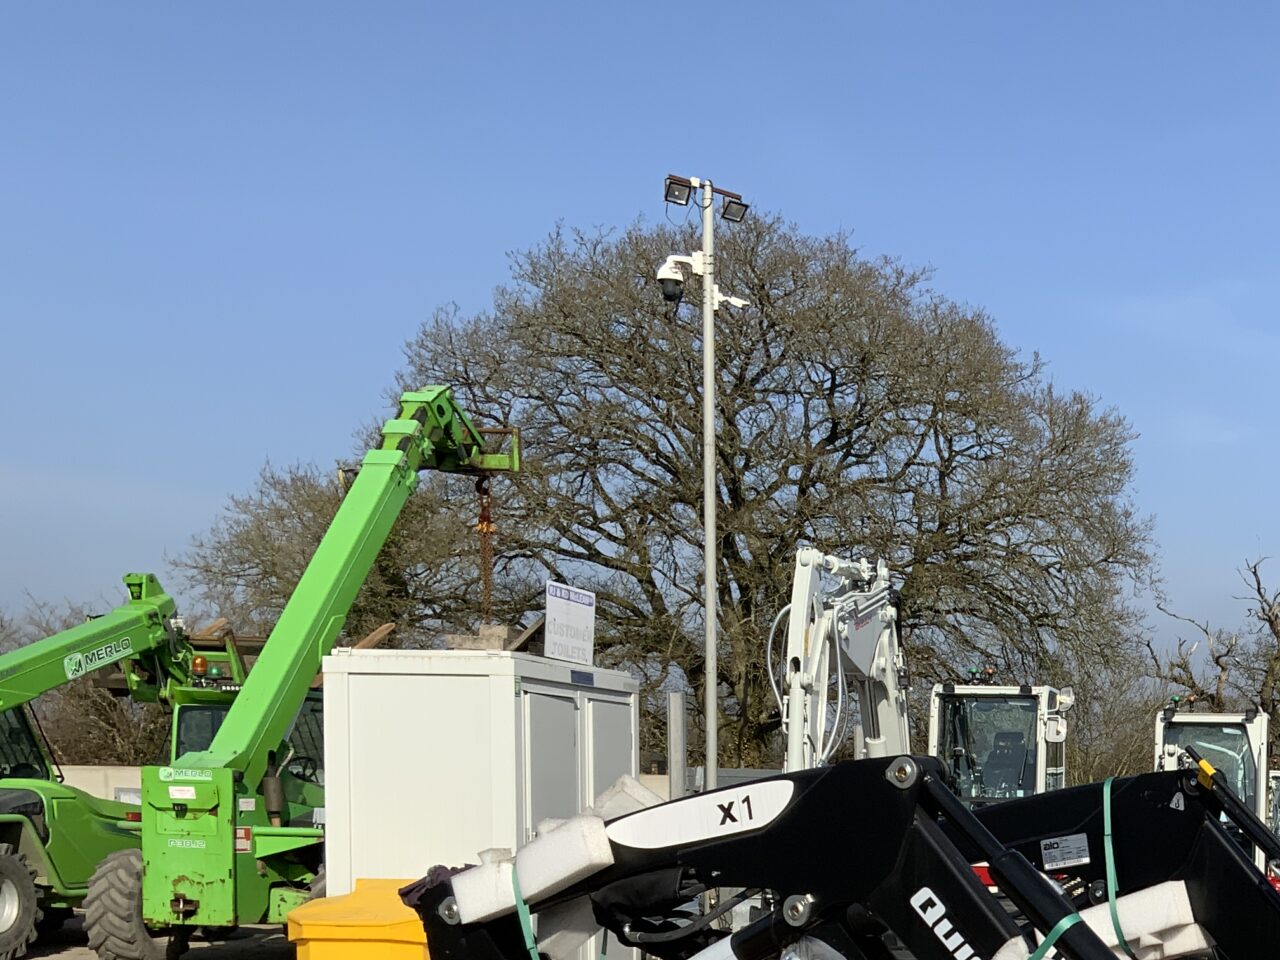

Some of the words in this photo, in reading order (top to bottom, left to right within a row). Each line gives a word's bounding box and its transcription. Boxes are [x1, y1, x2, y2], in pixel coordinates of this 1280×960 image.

[547, 621, 592, 642] CUSTOMER
[85, 638, 131, 665] MERLO
[553, 642, 587, 660] TOILETS
[175, 769, 212, 778] MERLO
